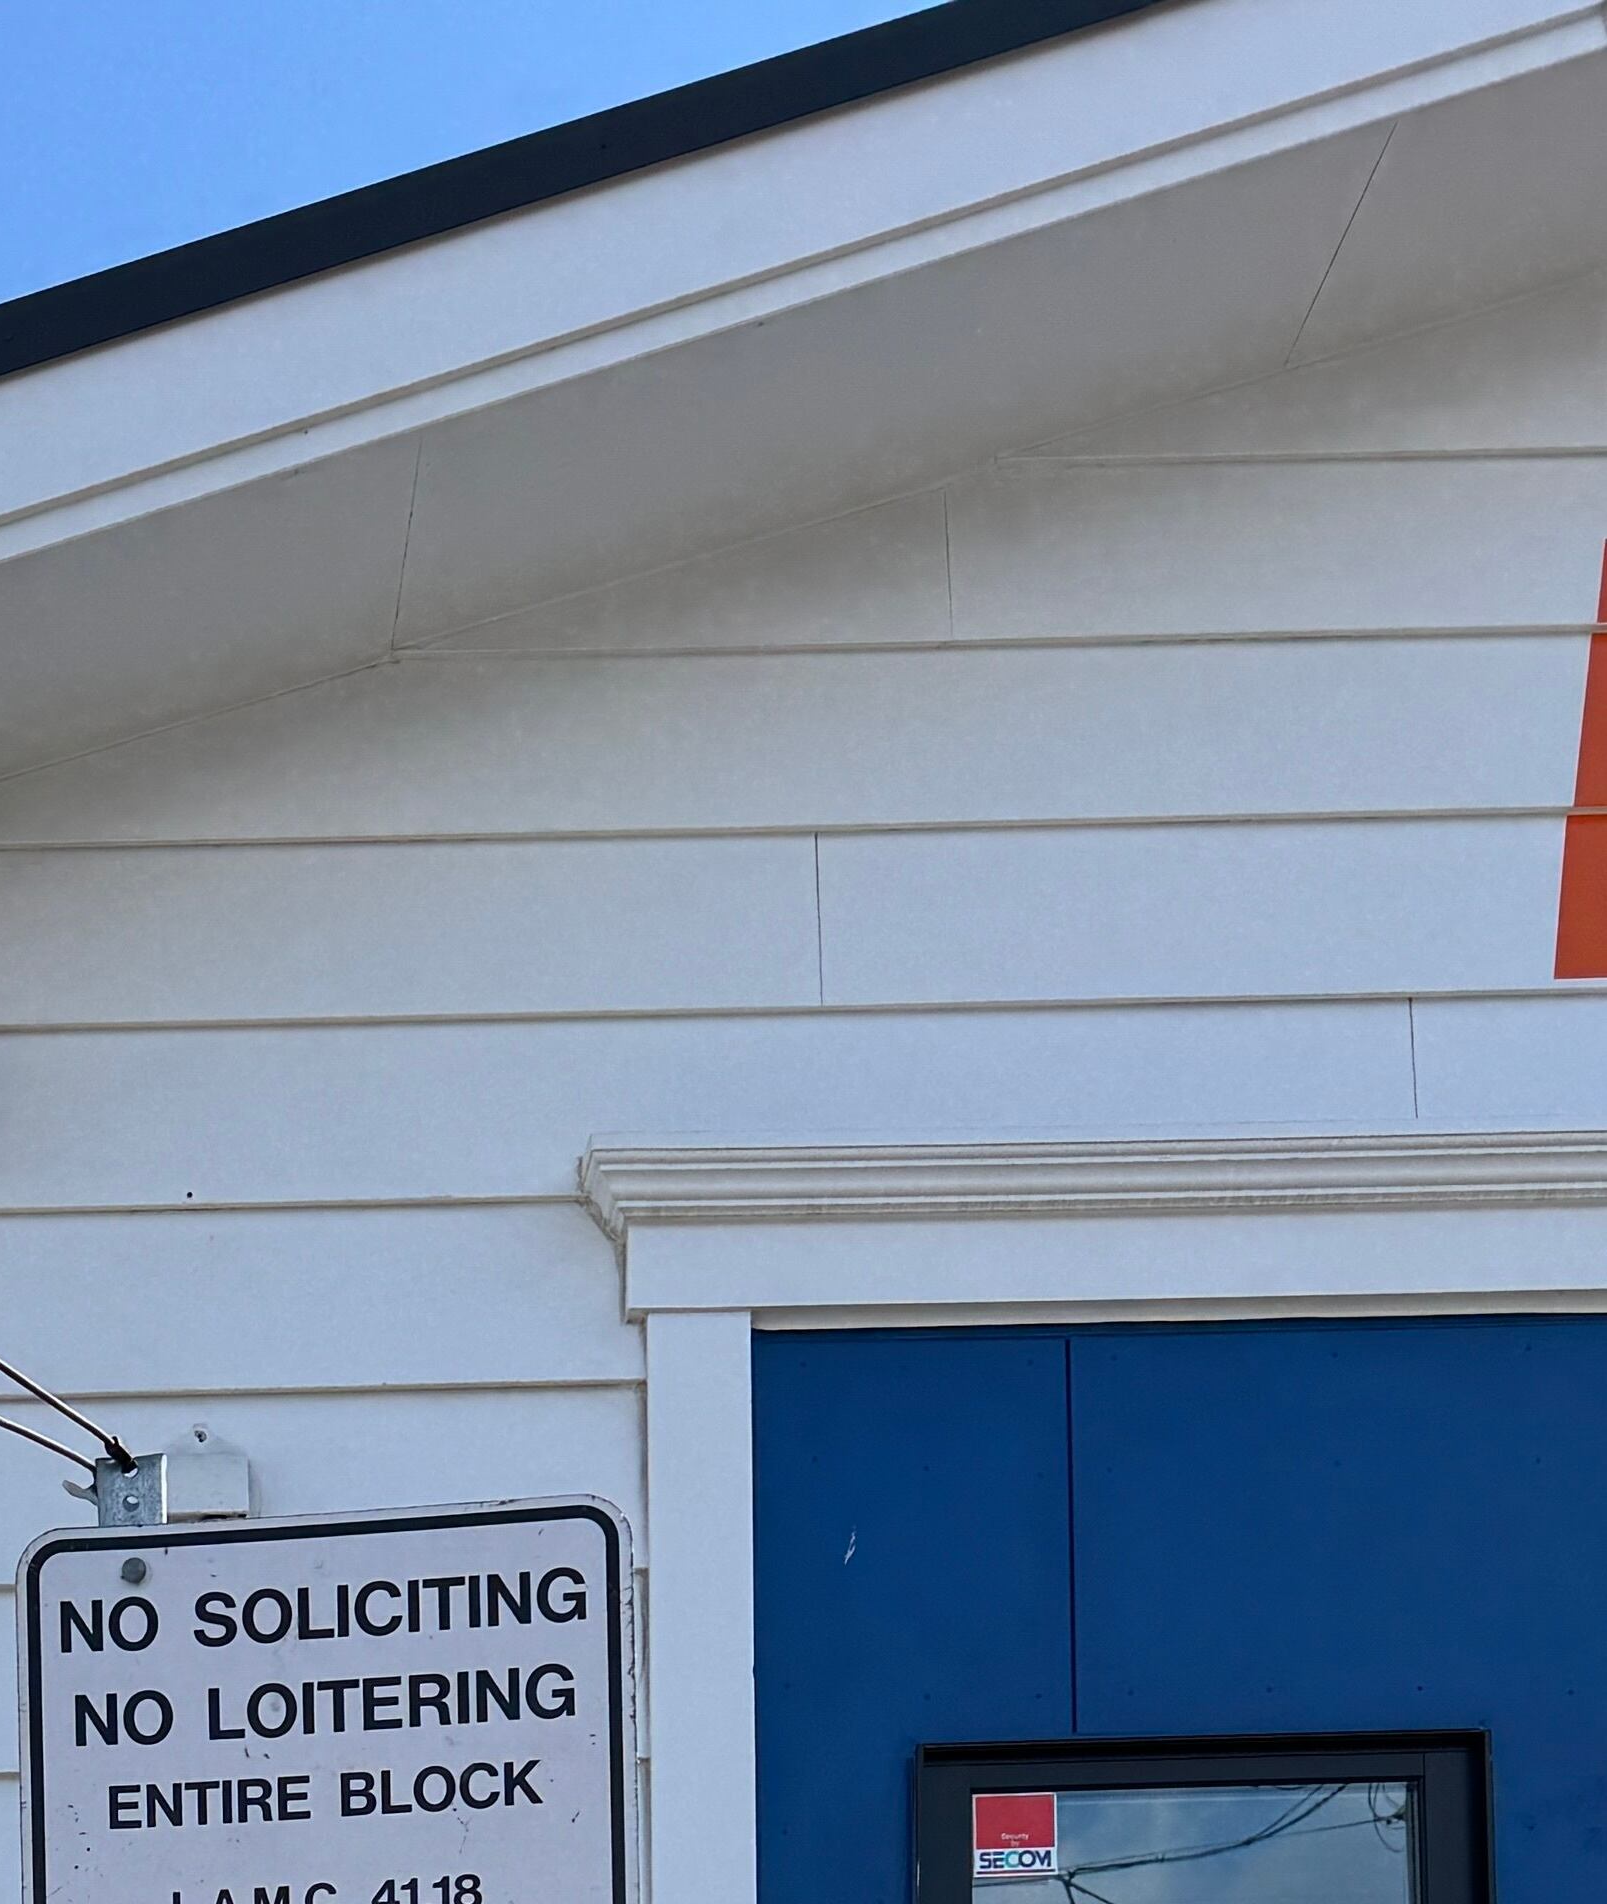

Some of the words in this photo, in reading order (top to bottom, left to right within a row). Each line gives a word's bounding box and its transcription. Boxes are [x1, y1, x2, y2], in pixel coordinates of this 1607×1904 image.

[60, 1597, 159, 1654] NO
[193, 1566, 588, 1648] SOLICITING
[74, 1689, 174, 1747] NO
[207, 1663, 577, 1741] LOITERING
[108, 1775, 312, 1830] ENTIRE
[340, 1759, 544, 1818] BLOCK
[979, 1850, 1051, 1869] SECOM
